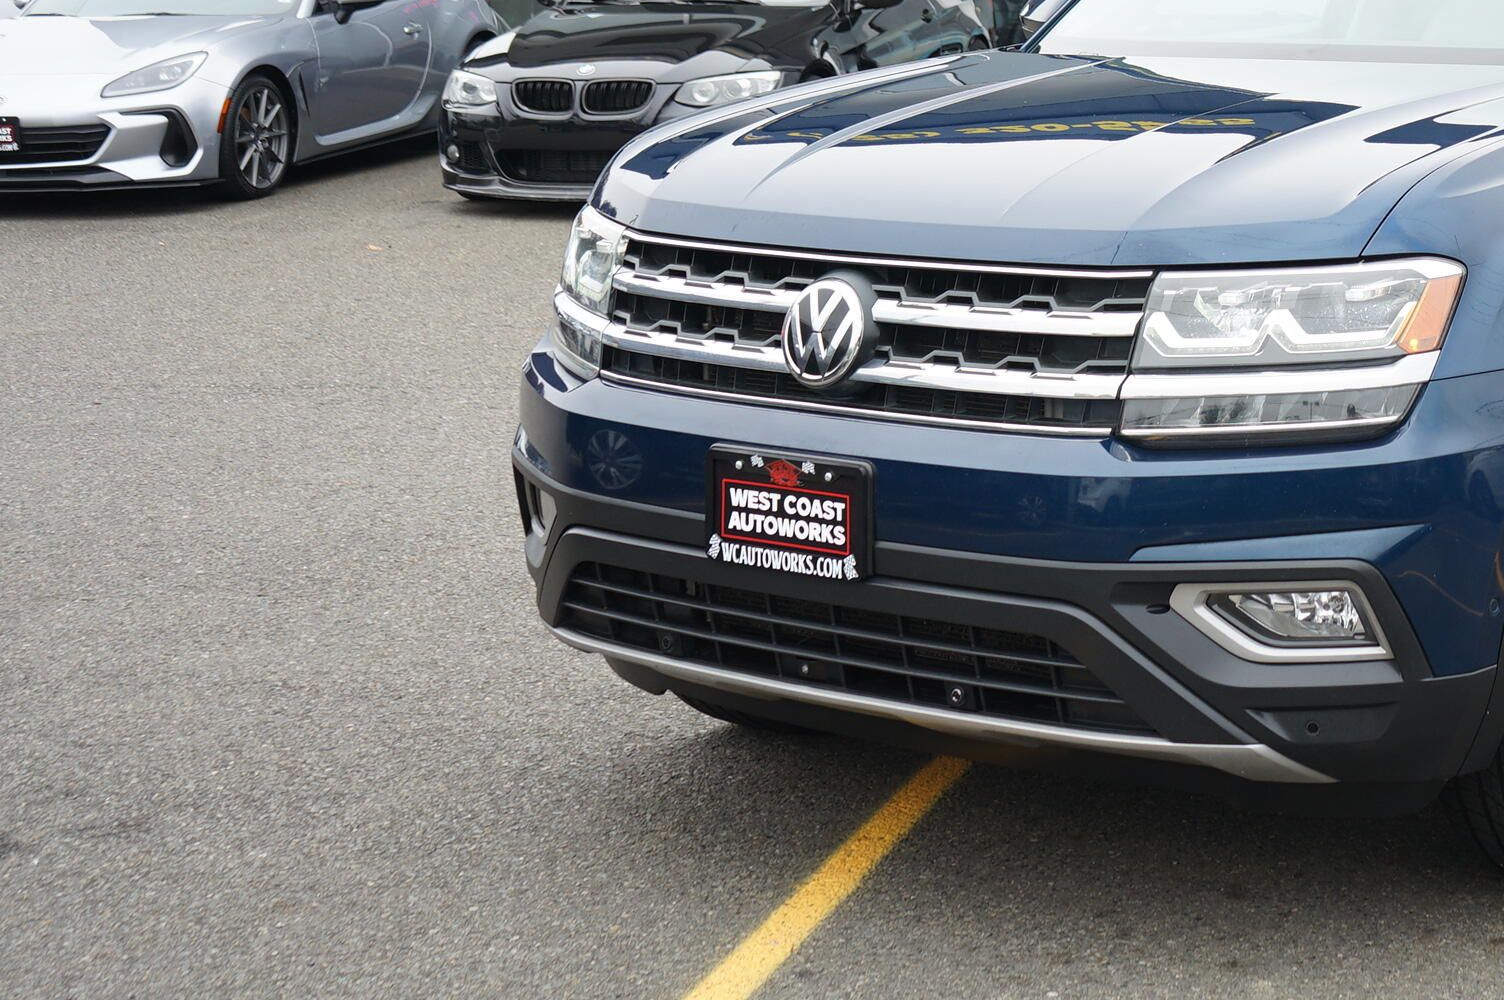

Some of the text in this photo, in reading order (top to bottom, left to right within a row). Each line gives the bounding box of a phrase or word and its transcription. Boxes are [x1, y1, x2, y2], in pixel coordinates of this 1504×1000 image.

[729, 487, 845, 521] WEST COAST
[728, 511, 846, 546] AUTOWORKS
[721, 541, 843, 579] WCAUTOWORKS.COM
